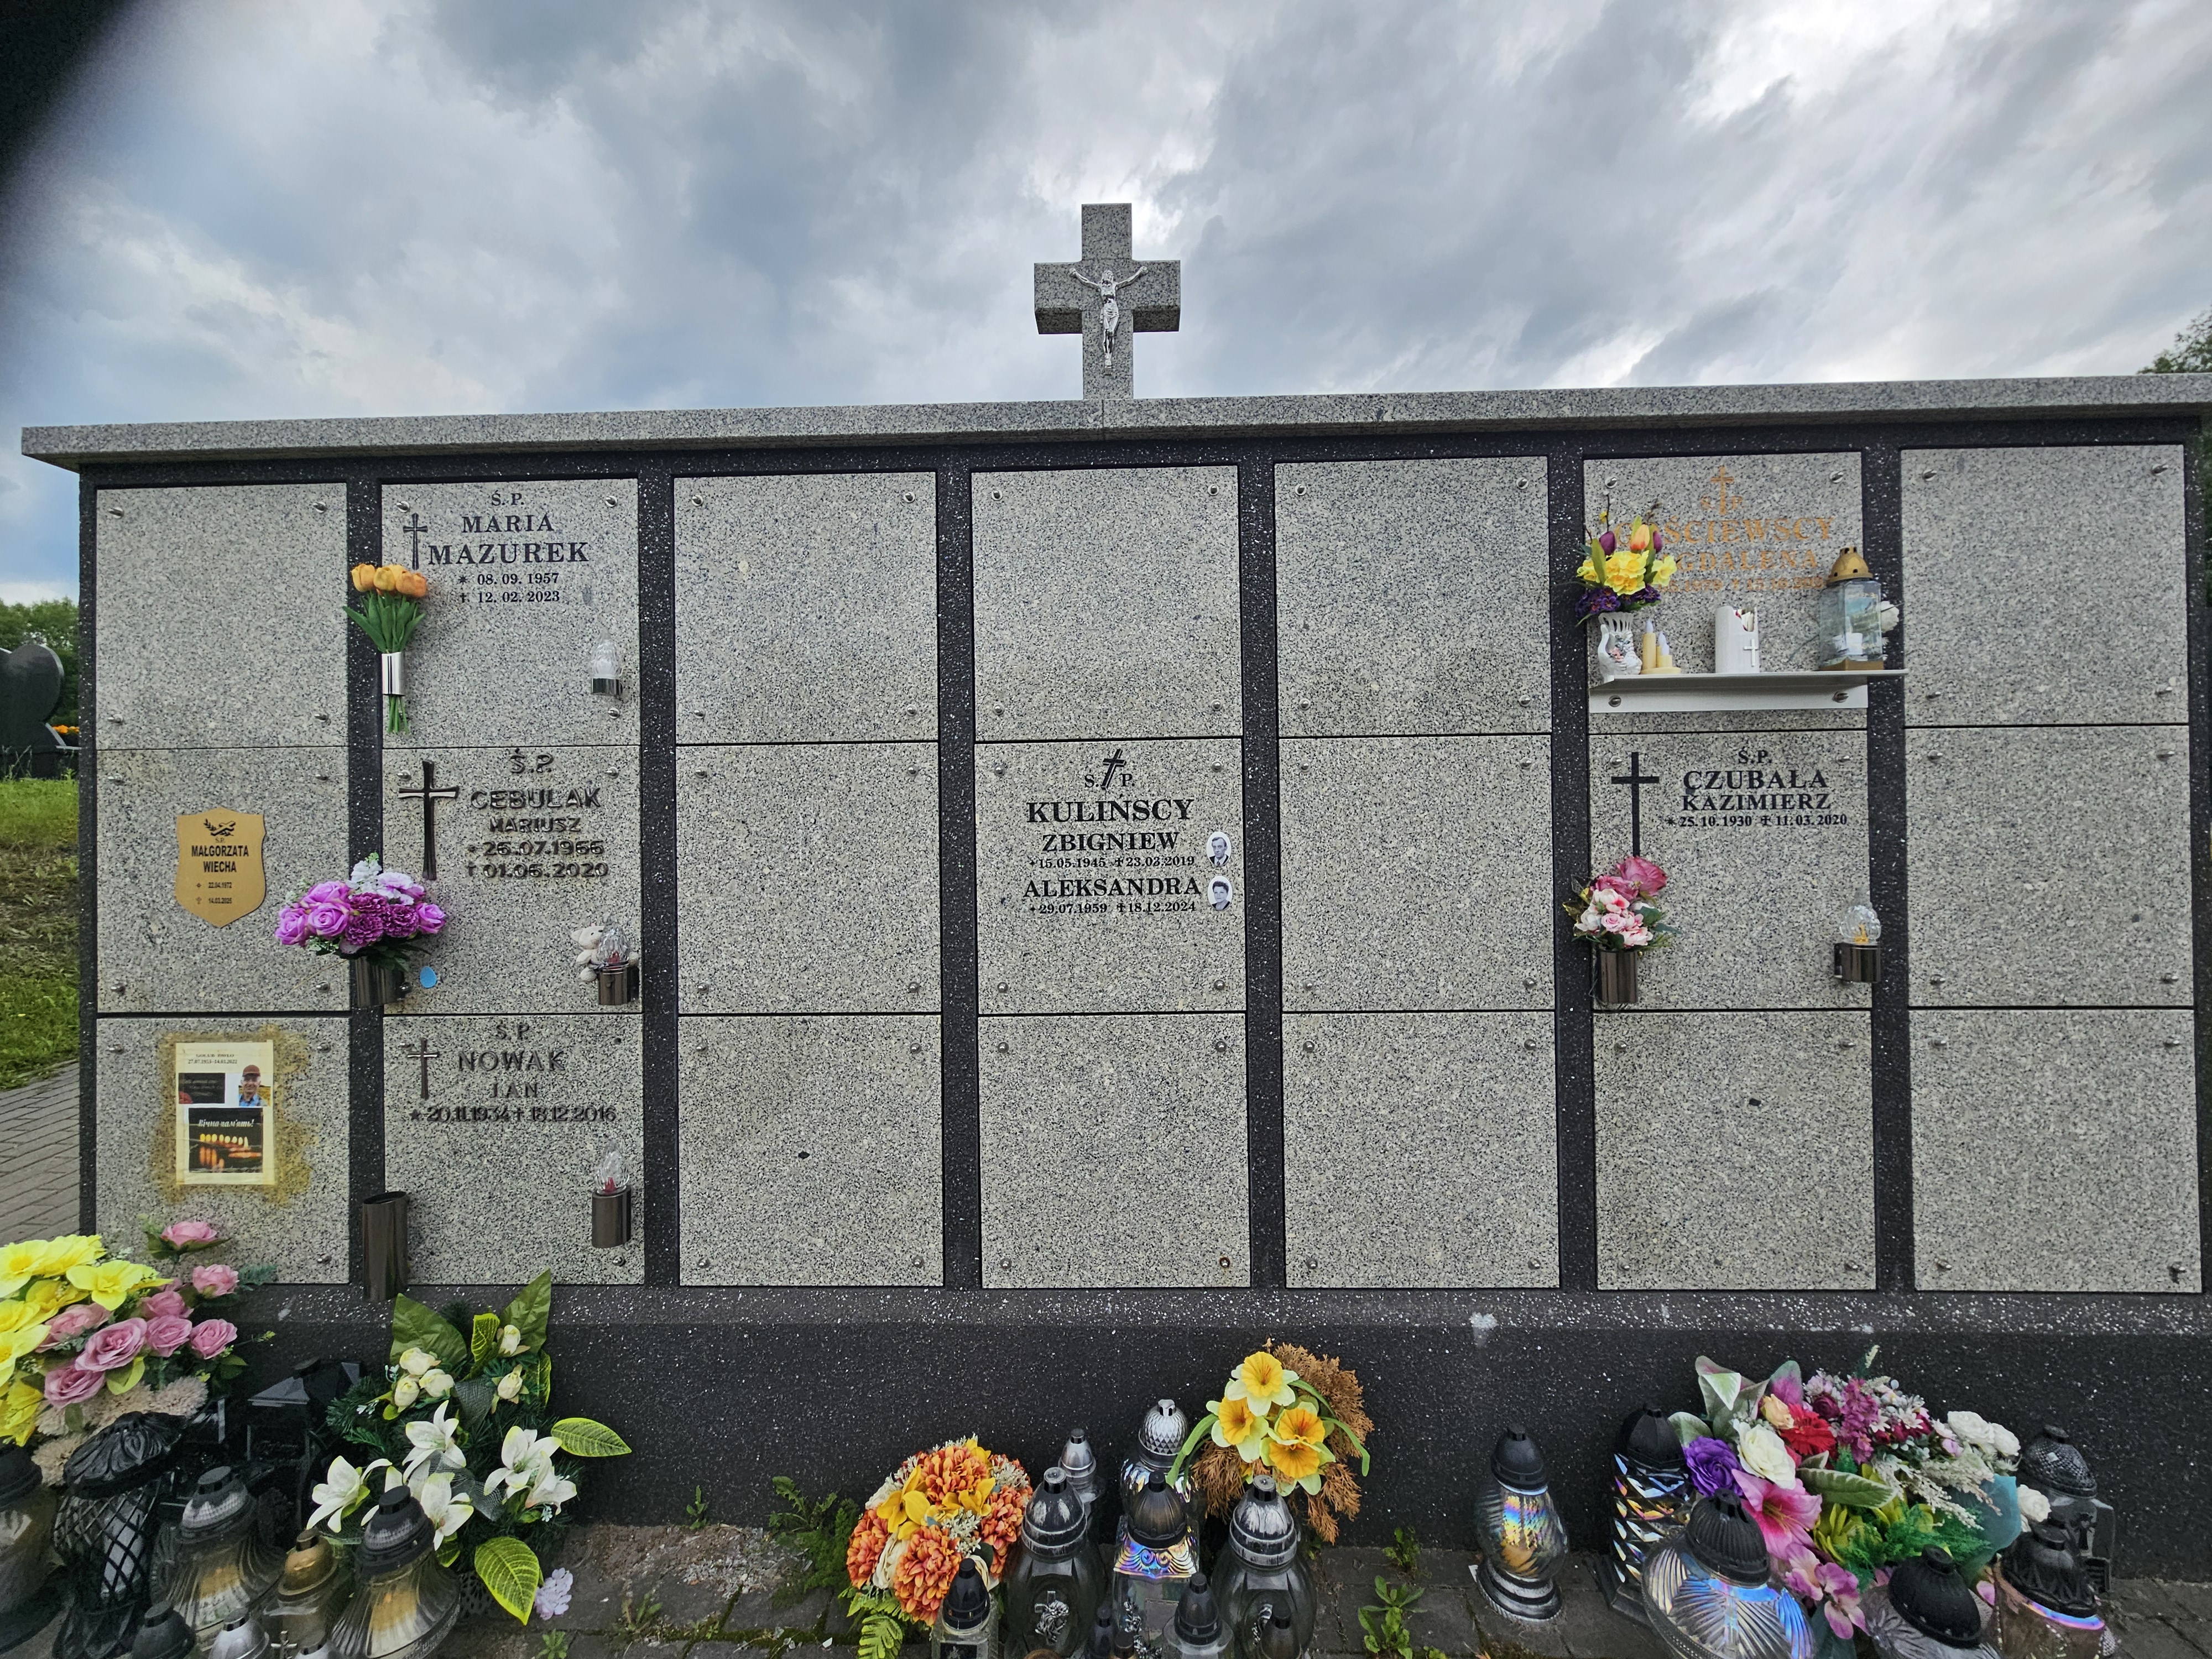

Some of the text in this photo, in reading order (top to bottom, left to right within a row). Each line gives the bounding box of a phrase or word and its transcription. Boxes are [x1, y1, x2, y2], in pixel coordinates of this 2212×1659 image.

[461, 514, 554, 533] MARIA
[1615, 515, 1835, 546] GŚCIEWSCY
[428, 542, 590, 565] MAZUREK
[1661, 549, 1818, 572] GDALENA
[527, 572, 560, 585] 1957
[1746, 576, 1827, 591] 15.10.202
[526, 591, 560, 603] 2023
[1683, 770, 1829, 790] CZUBAŁA
[470, 787, 602, 810] CEBULAK
[1682, 792, 1831, 811] KAZIMIERZ
[1026, 794, 1195, 823] KULIŃSCY
[489, 817, 582, 833] MARIUSZ
[191, 845, 249, 857] MAŁGORZATA
[483, 840, 605, 856] 26.07.1966
[1041, 831, 1180, 852] ZBIGNIEW
[203, 861, 237, 873] WIECHA
[483, 862, 609, 878] 01.06.2020
[1023, 877, 1202, 898] ALEKSANDRA
[1129, 902, 1196, 914] 18.12.2024
[458, 1050, 566, 1072] NOWAK
[490, 1082, 539, 1098] JAN
